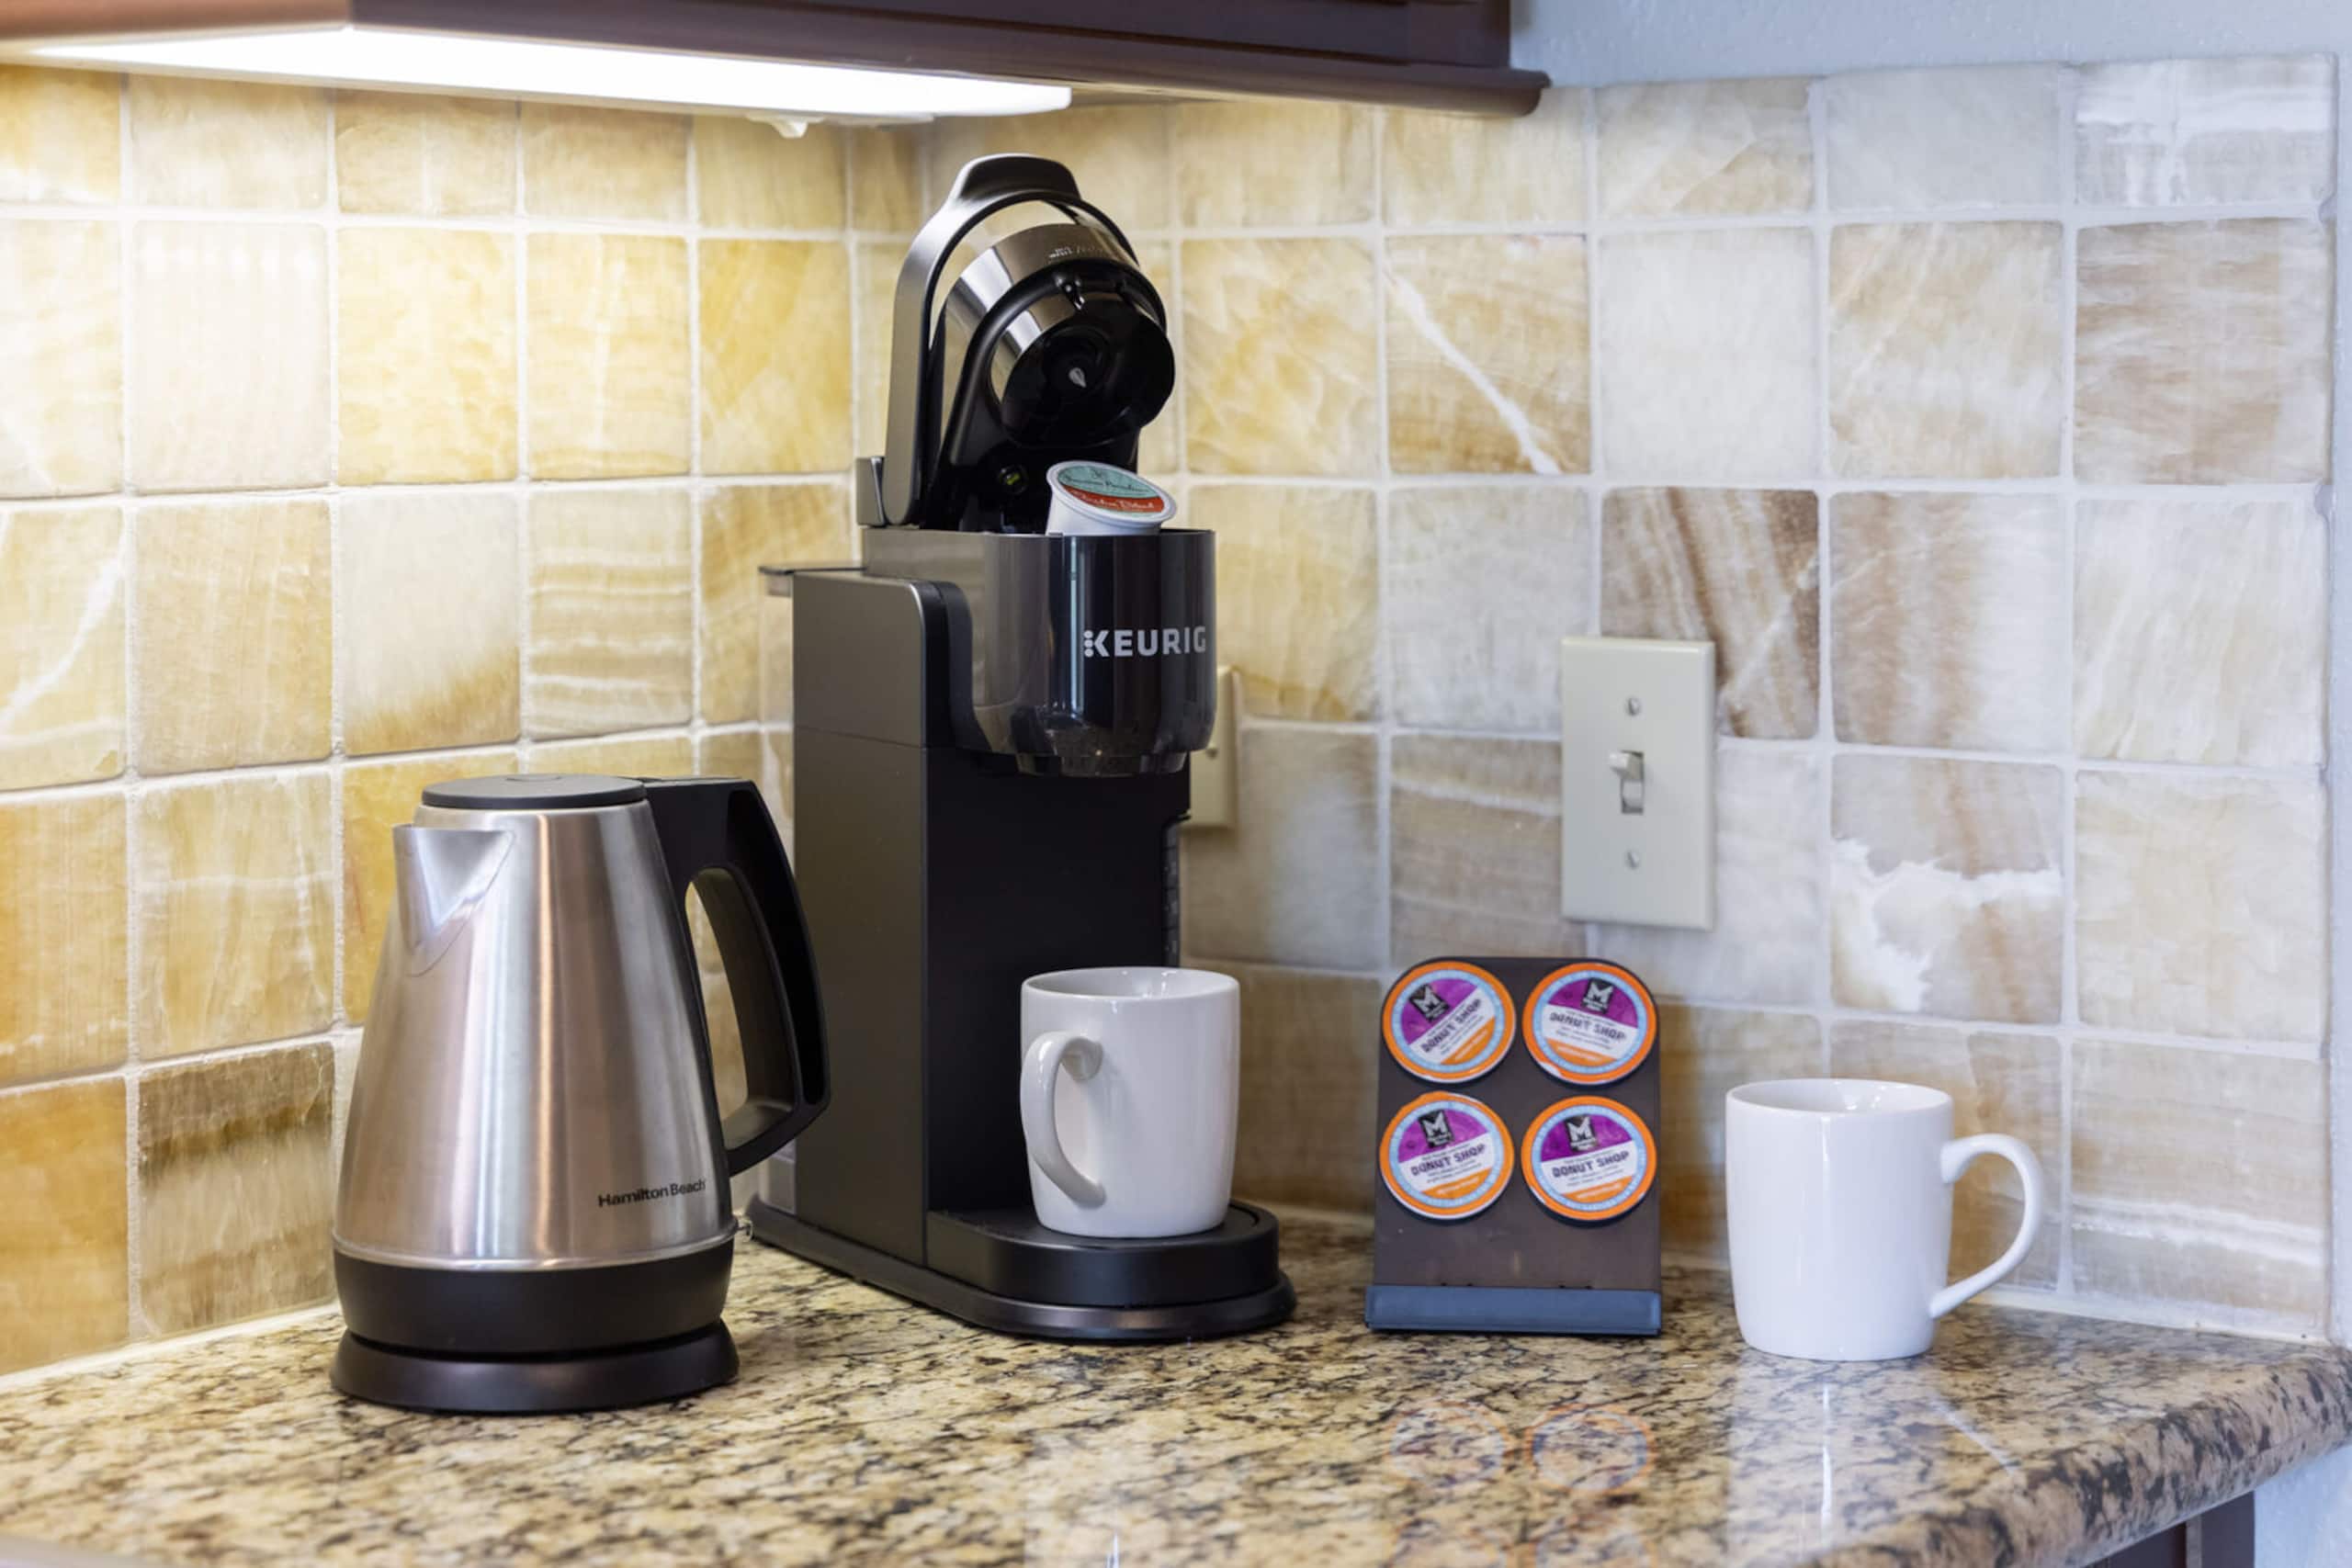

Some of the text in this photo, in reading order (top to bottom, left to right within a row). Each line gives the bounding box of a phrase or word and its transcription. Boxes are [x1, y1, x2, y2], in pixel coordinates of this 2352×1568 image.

[1083, 626, 1206, 658] KEURIG
[1421, 1023, 1456, 1053] DONUT
[1455, 998, 1481, 1024] SHOP
[1549, 1011, 1592, 1030] DONUT
[1593, 1023, 1627, 1041] SHOP
[1410, 1156, 1452, 1177] DONUT
[1453, 1143, 1486, 1162] SHOP
[1552, 1160, 1594, 1179] DONUT
[1596, 1150, 1630, 1168] SHOP
[598, 1179, 707, 1207] Hamilton Beach
